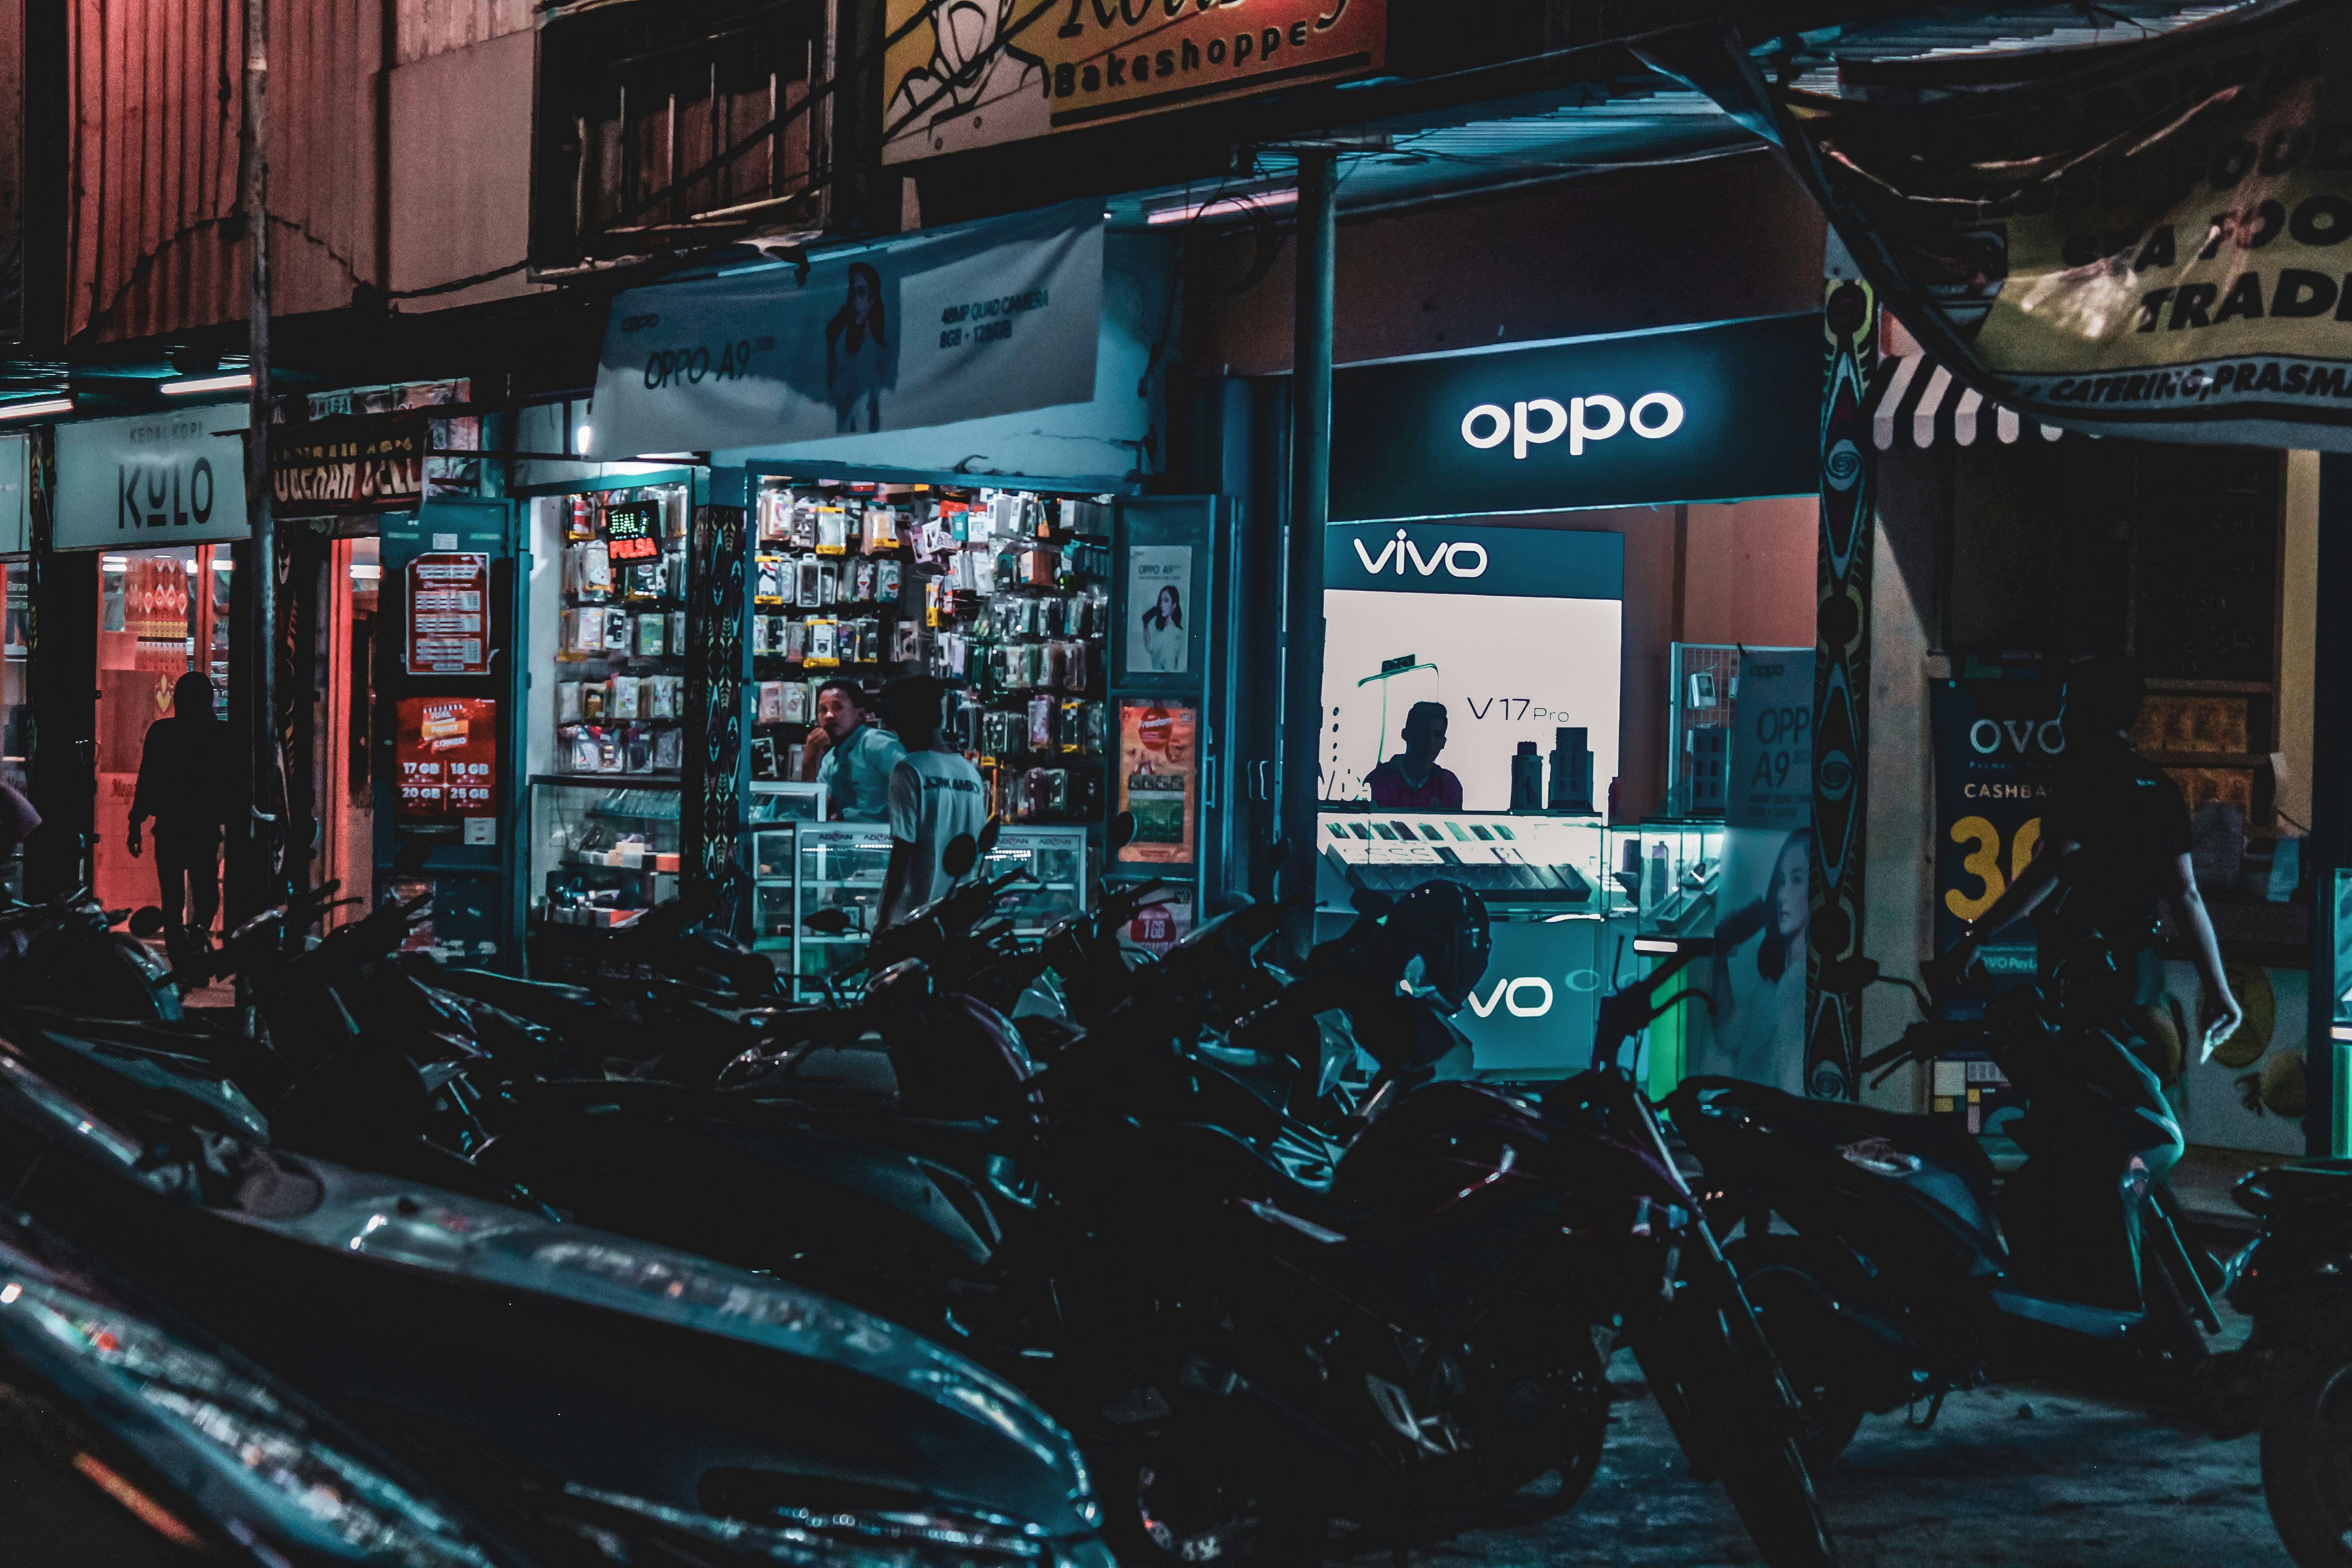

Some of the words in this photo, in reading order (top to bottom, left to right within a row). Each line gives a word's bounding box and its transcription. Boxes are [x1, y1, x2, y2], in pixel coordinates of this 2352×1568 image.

[1054, 20, 1308, 98] Bakeshoppe
[645, 347, 710, 390] OPPO
[715, 340, 751, 382] A9
[1460, 392, 1685, 459] oppo
[118, 456, 213, 529] KULO
[609, 538, 657, 559] PULSA
[1353, 528, 1488, 578] vivo
[1533, 707, 1569, 722] Pro
[1757, 707, 1811, 745] OPP
[1750, 751, 1790, 789] A9
[1964, 783, 2055, 799] CASHBA
[1468, 976, 1553, 1018] vo
